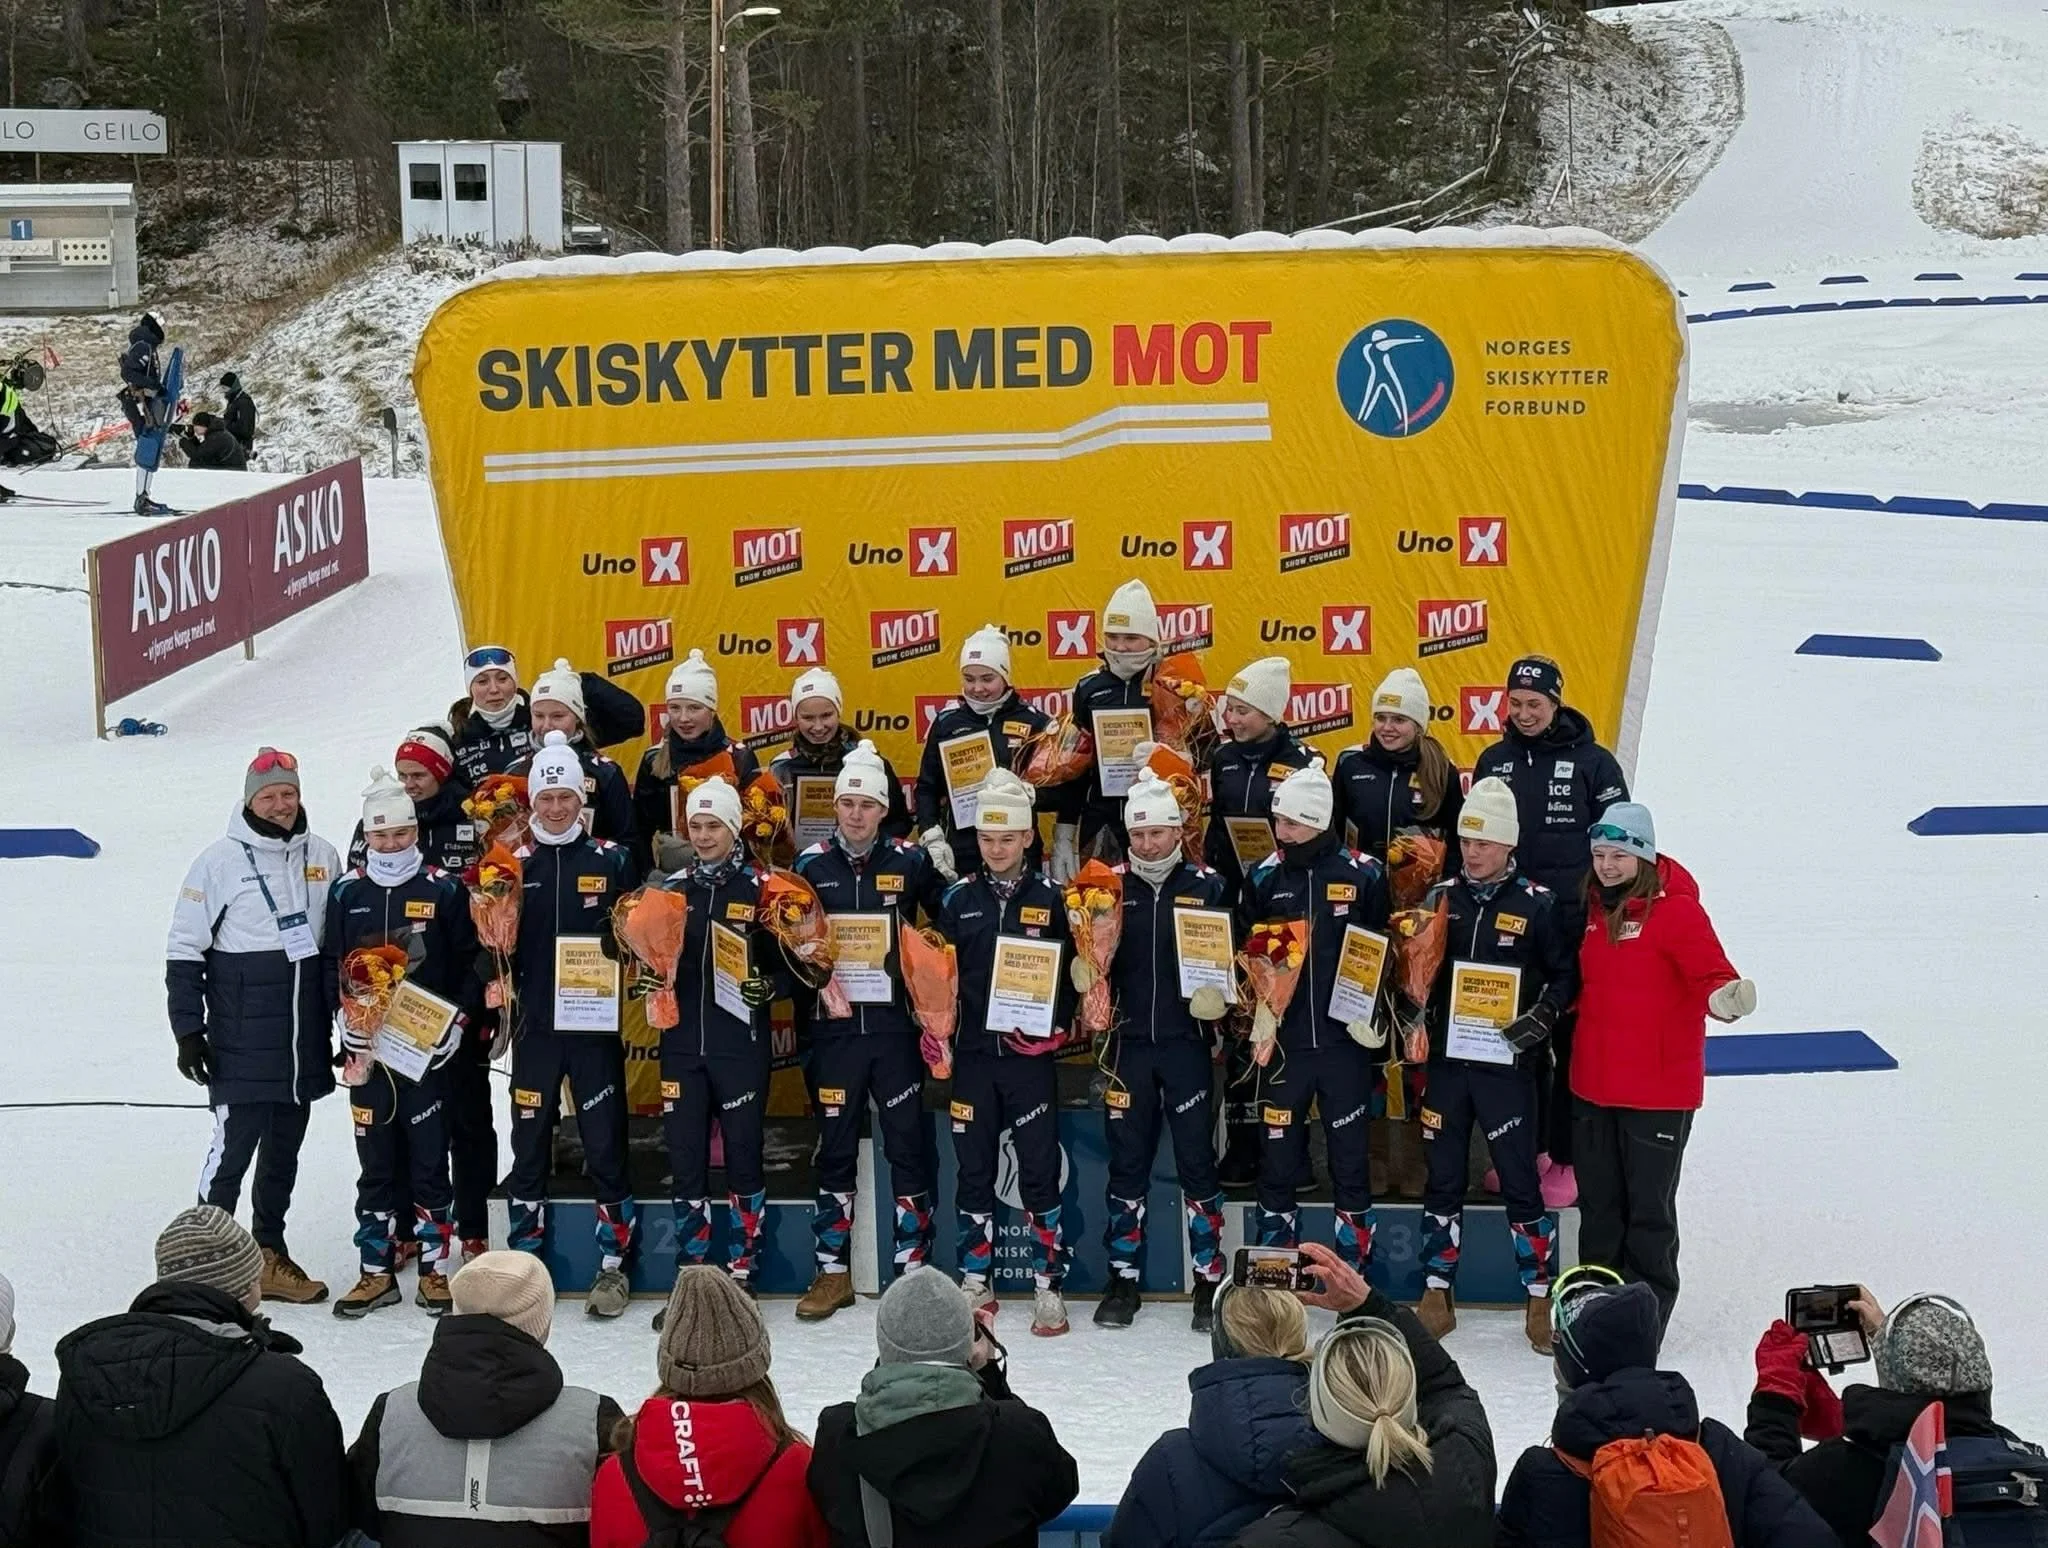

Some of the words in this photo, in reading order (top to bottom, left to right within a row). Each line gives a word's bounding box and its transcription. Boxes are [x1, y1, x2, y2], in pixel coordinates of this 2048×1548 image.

[84, 122, 161, 141] GEILO
[16, 221, 26, 239] 1
[478, 332, 913, 411] SKISKYTTER
[934, 326, 1093, 391] MED
[1113, 321, 1272, 386] MOT
[1486, 340, 1572, 357] NORGES
[1486, 370, 1609, 386] SKISKYTTER
[1485, 400, 1586, 416] FORBUND
[273, 479, 344, 573] ASKO
[1013, 519, 1074, 558] MOT
[1289, 514, 1350, 553] MOT
[1397, 530, 1454, 553] Uno
[1467, 521, 1502, 562] X
[582, 553, 636, 576] Uno
[649, 542, 682, 582] X
[743, 528, 801, 567] MOT
[848, 542, 904, 565] Uno
[918, 532, 951, 573] X
[1010, 564, 1031, 575] SHOW
[1033, 552, 1071, 570] COURAGE!
[1121, 535, 1177, 558] Uno
[1190, 526, 1227, 567] X
[1285, 558, 1306, 570] SHOW
[1309, 547, 1346, 564] COURAGE!
[131, 527, 221, 633] ASKO
[740, 573, 760, 584] SHOW
[762, 562, 799, 578] COURAGE!
[880, 610, 938, 649] MOT
[1056, 616, 1090, 655] X
[1261, 620, 1316, 642] Uno
[1329, 611, 1365, 651] X
[1428, 601, 1487, 638] MOT
[615, 618, 672, 657] MOT
[718, 633, 772, 656] Uno
[785, 623, 819, 664] X
[876, 653, 898, 664] SHOW
[900, 644, 936, 658] COURAGE!
[1423, 643, 1445, 654] SHOW
[1447, 635, 1484, 648] COURAGE!
[612, 663, 632, 674] SHOW
[634, 652, 670, 669] COURAGE!
[750, 699, 793, 733] MO
[856, 710, 910, 730] Uno
[1293, 685, 1352, 721] MOT
[1468, 692, 1504, 731] X
[1311, 718, 1349, 731] COURAGE!
[1548, 780, 1571, 796] ice
[583, 1088, 608, 1110] CRAFT
[1015, 1106, 1041, 1126] CRAFT
[1332, 1109, 1360, 1128] CRAFT
[1487, 1120, 1513, 1140] CRAFT
[653, 1218, 678, 1253] 2
[998, 1226, 1032, 1237] NOR
[1388, 1224, 1412, 1261] 3
[670, 1401, 703, 1491] CRAFT
